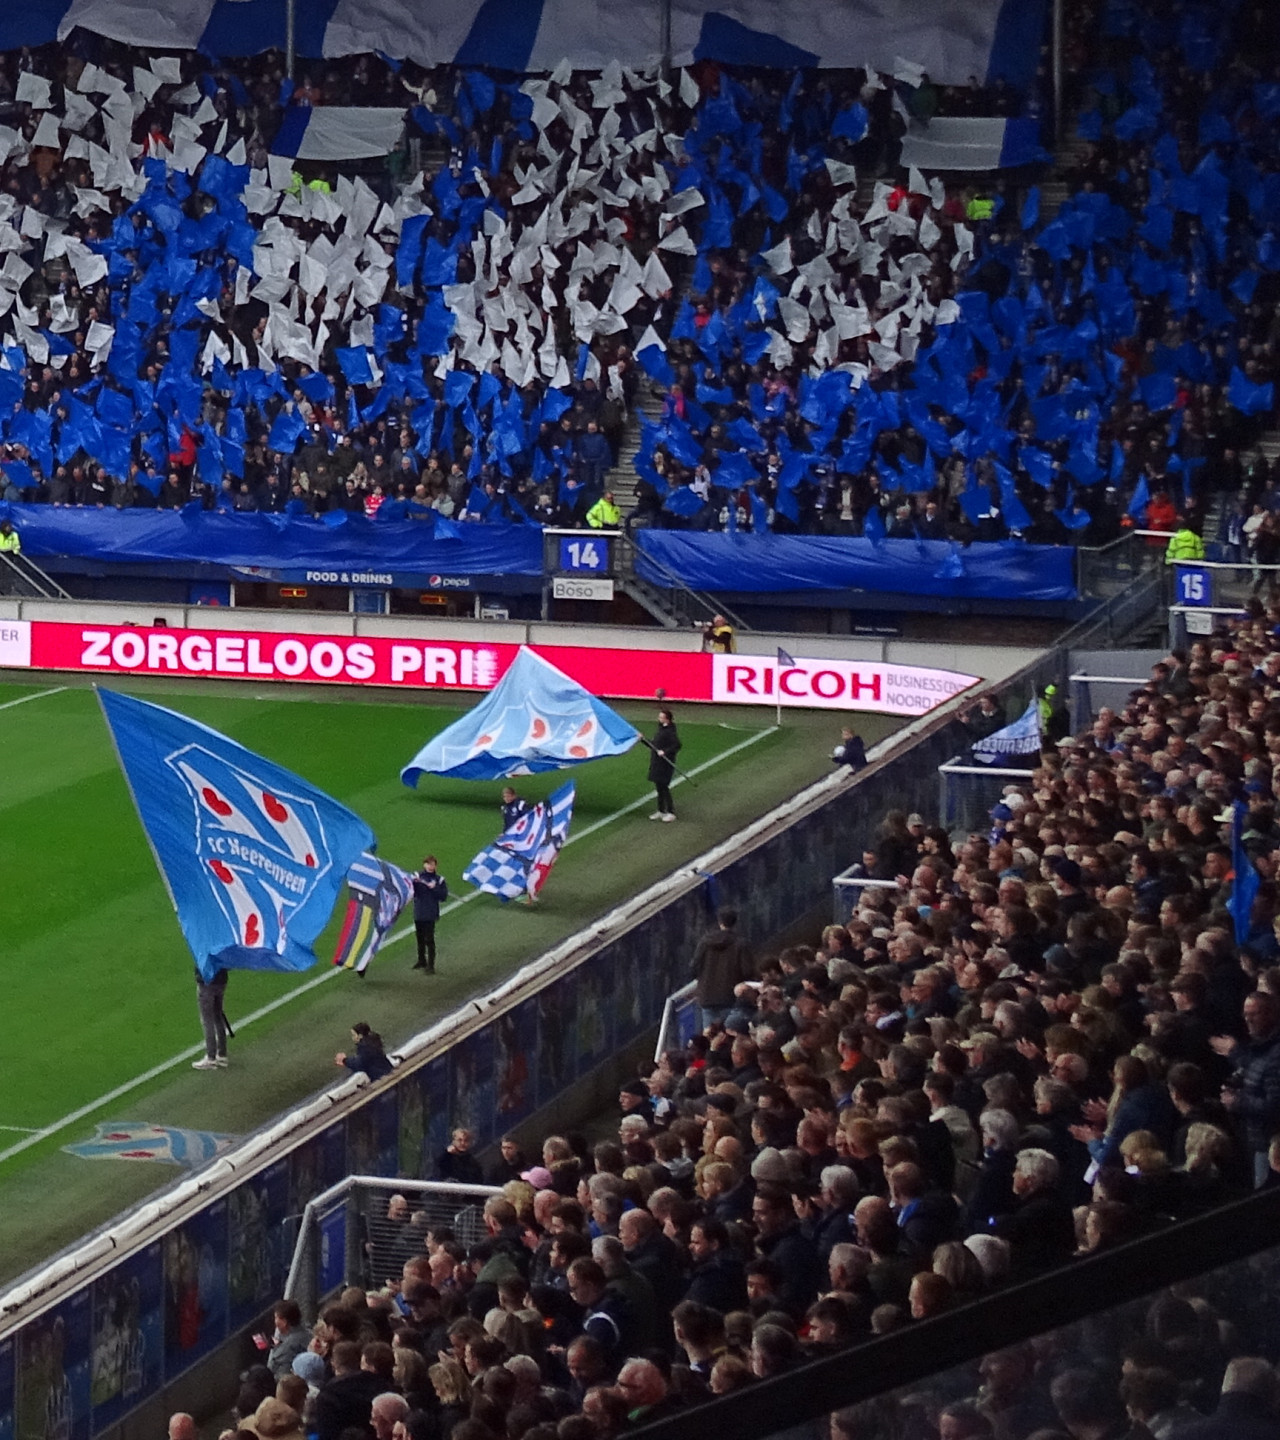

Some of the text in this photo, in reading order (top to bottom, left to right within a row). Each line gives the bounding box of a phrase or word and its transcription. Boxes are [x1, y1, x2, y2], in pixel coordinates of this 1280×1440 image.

[567, 542, 600, 569] 14
[306, 571, 338, 583] FOOD
[352, 572, 393, 585] DRINKS
[1181, 573, 1204, 600] 15
[81, 631, 376, 680] ZORGELOOS
[726, 665, 881, 701] RICOH
[887, 672, 942, 692] BUSINESS
[887, 692, 931, 709] NOORD
[227, 837, 306, 895] Heerenveen
